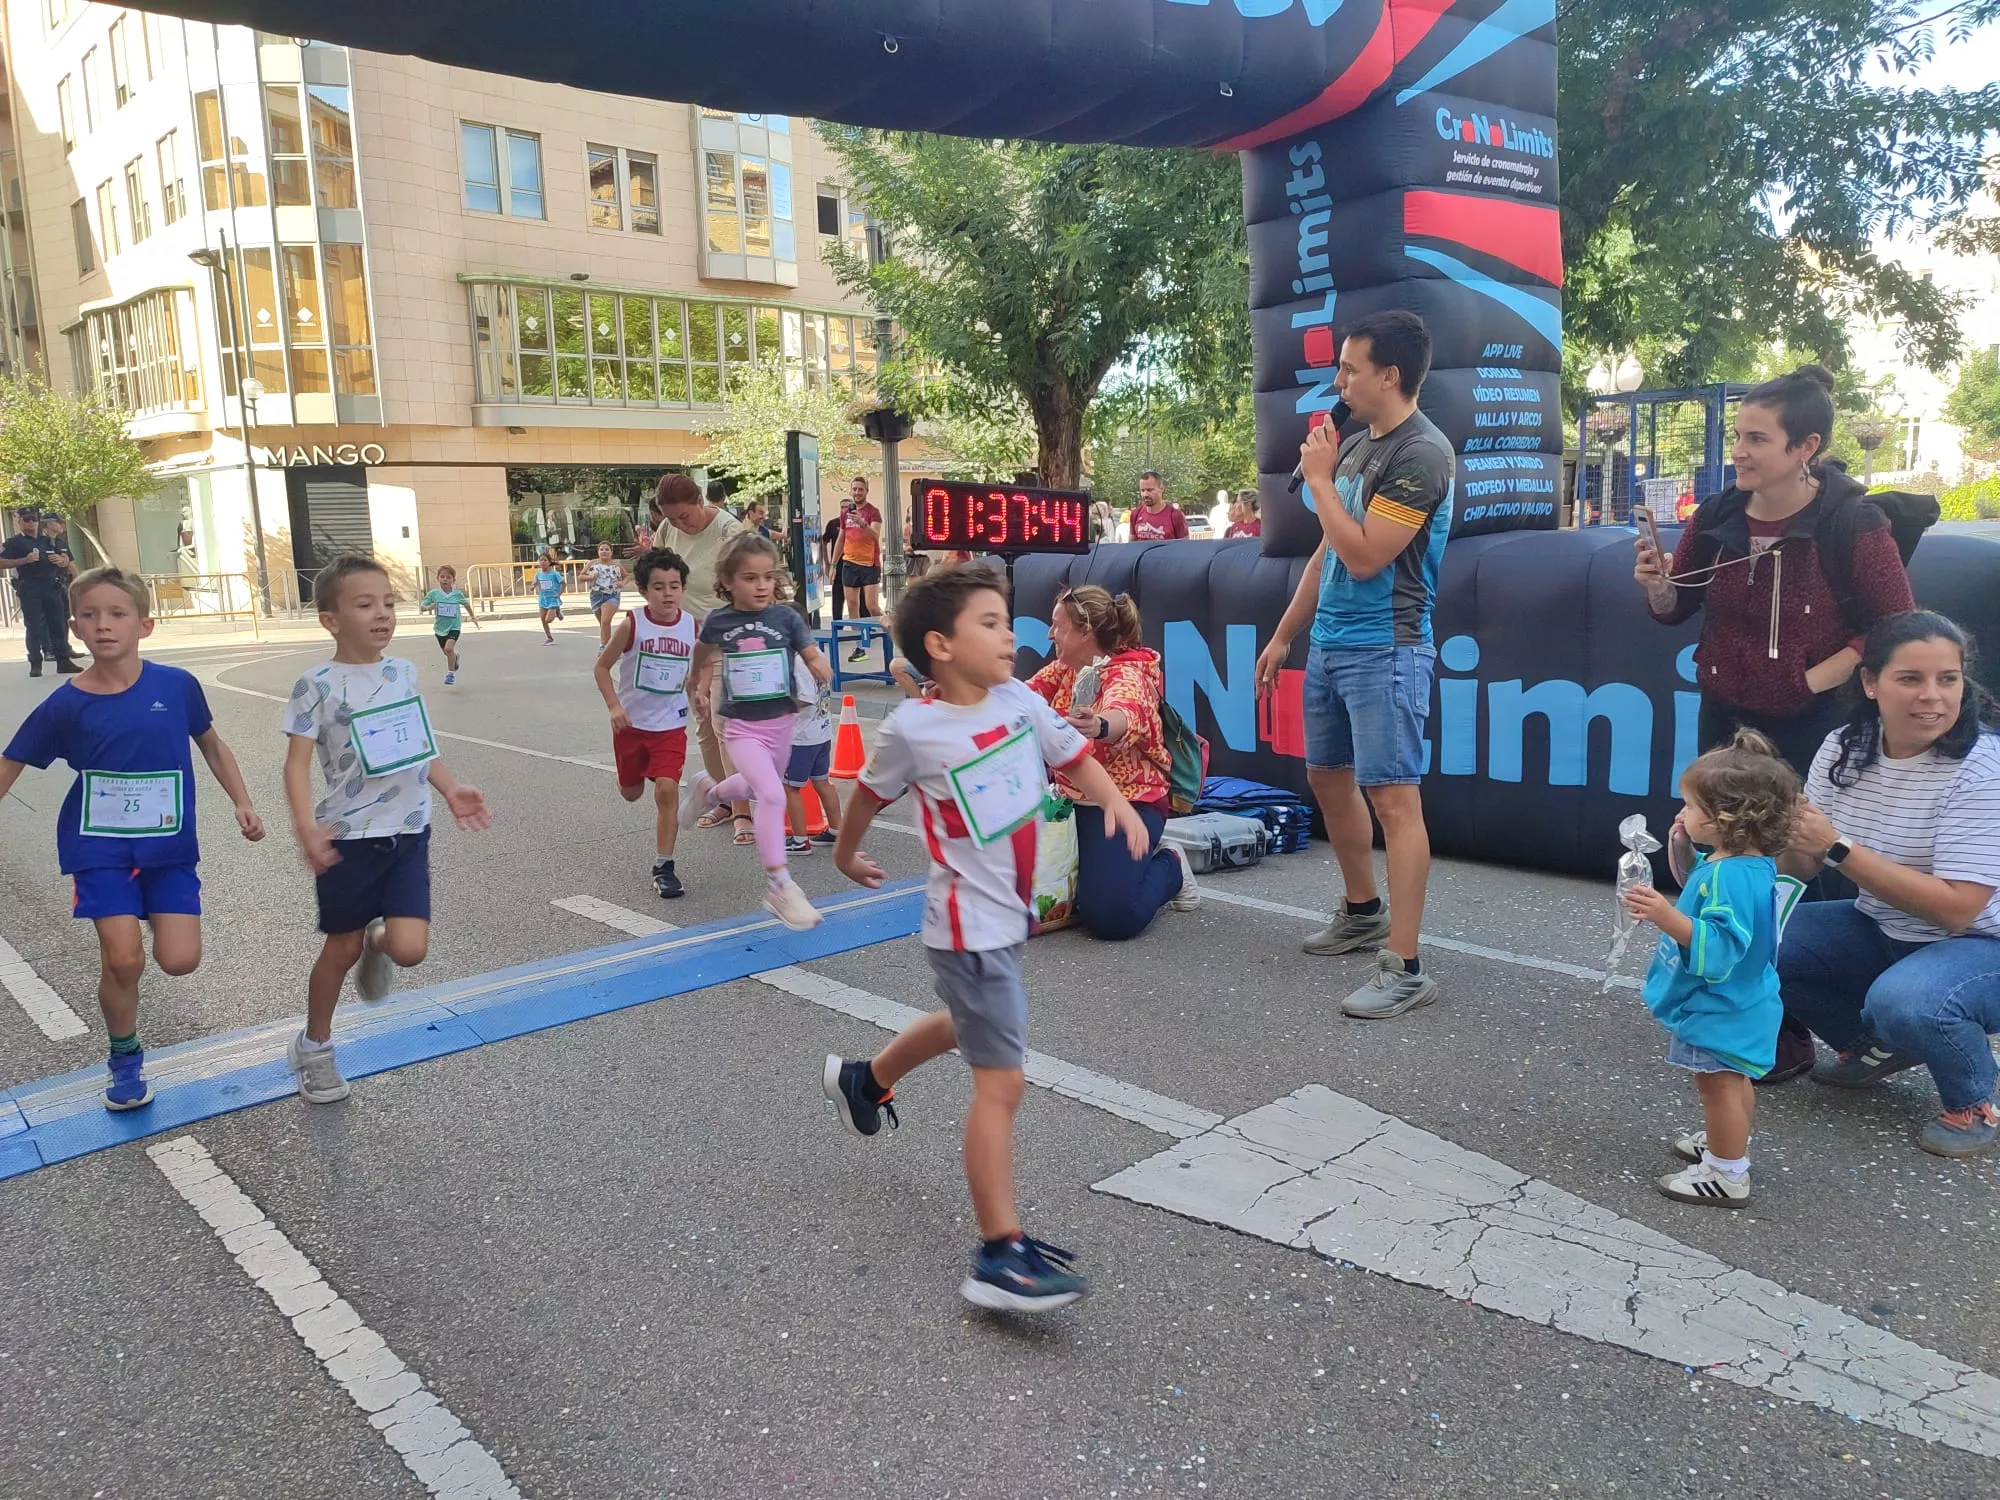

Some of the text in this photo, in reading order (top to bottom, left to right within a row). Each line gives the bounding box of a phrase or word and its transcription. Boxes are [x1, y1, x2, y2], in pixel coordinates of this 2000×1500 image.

[1453, 149, 1540, 179] Servicio de cronometraje y
[1446, 169, 1543, 194] gestión de eventos deportivos
[1482, 343, 1524, 359] APP LIVE
[1476, 367, 1522, 379] DORSALES
[1472, 384, 1541, 402] VÍDEO RESUMEN
[1475, 411, 1543, 427] VALLAS Y ARCOS
[1464, 436, 1542, 452] BOLSA CORREDOR
[263, 443, 385, 467] MANGO
[1464, 455, 1544, 472] SPEAKER Y SONIDO
[1465, 479, 1554, 497] TROFEOS Y MEDALLAS
[927, 488, 1081, 543] 01:37:44
[1463, 502, 1553, 522] CHIP ACTIVO Y PASIVO
[394, 727, 409, 744] 21
[123, 799, 140, 812] 25
